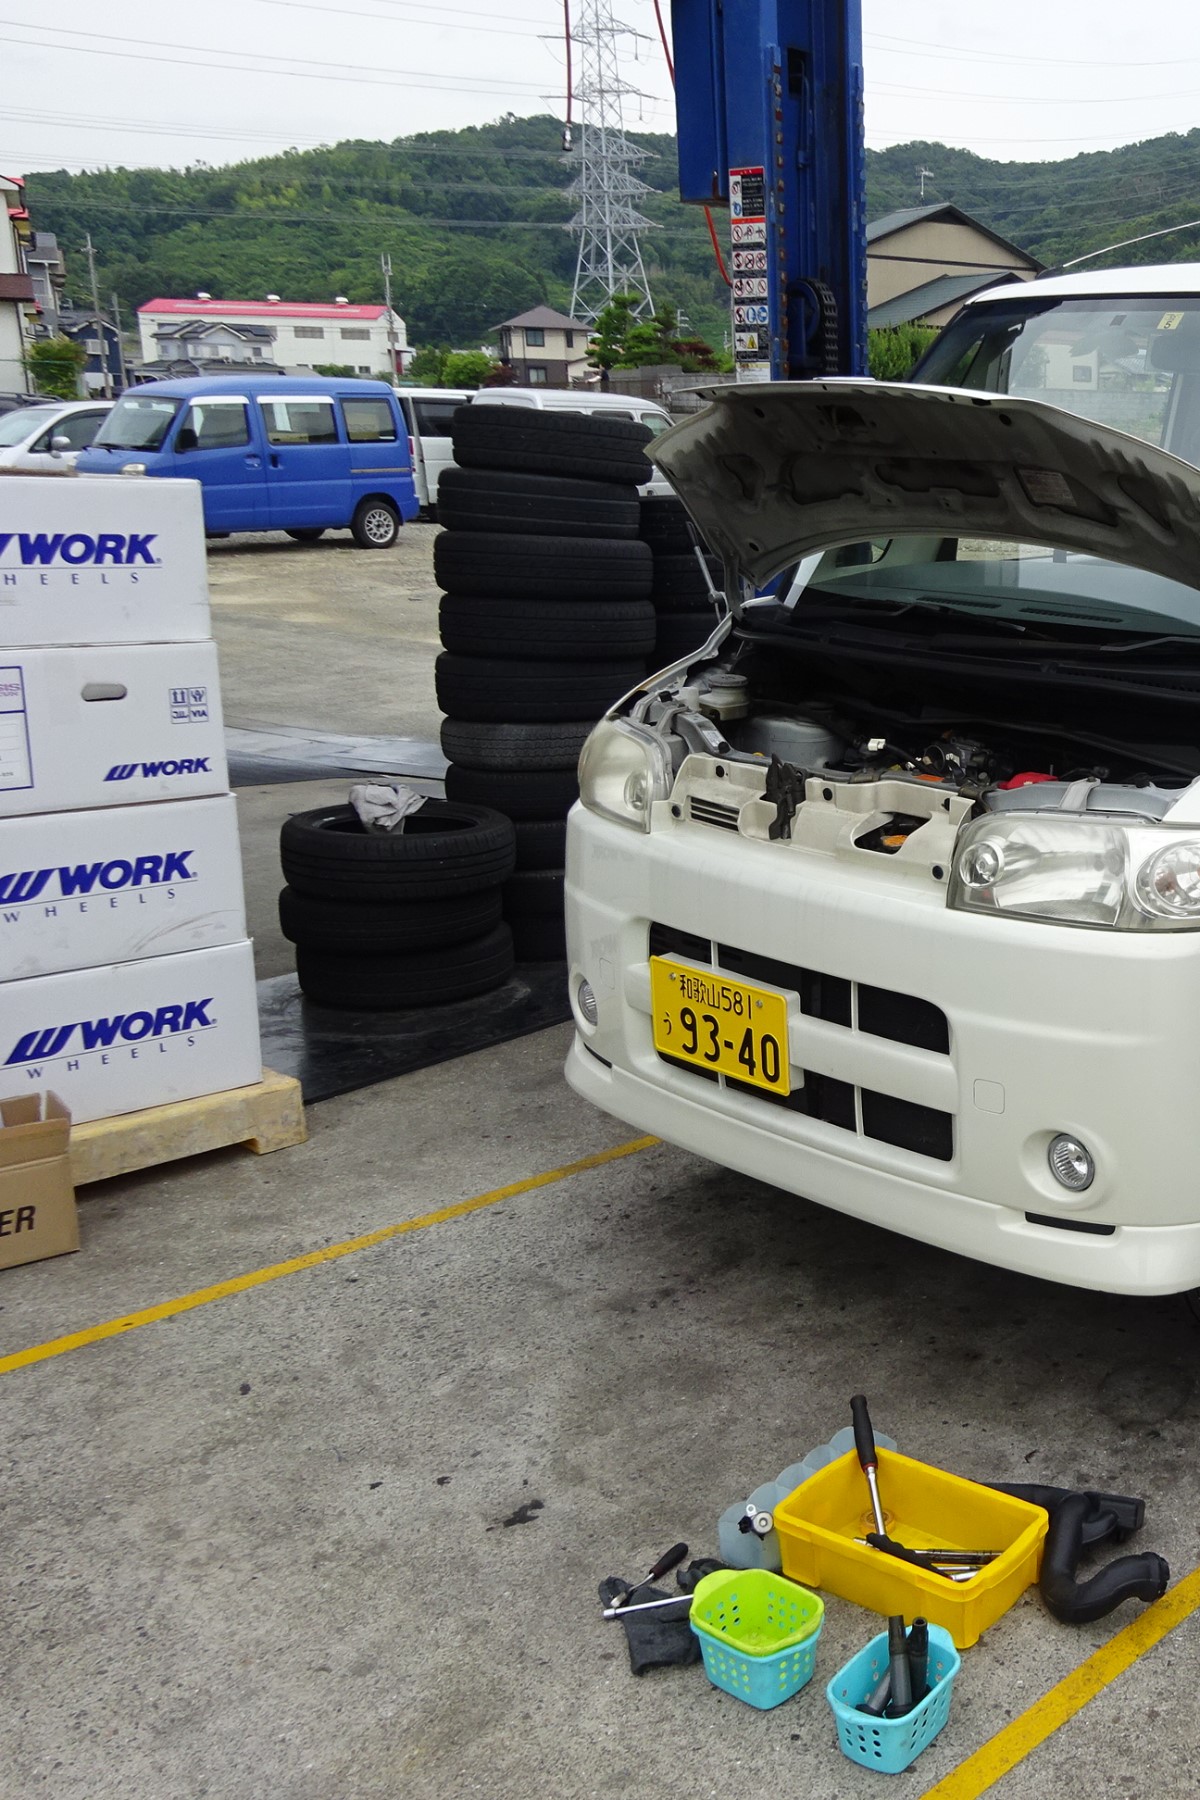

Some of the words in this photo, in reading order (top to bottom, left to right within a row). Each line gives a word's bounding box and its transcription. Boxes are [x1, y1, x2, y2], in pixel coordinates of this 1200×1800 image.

[18, 533, 159, 565] WORK
[141, 757, 211, 778] WORK
[59, 850, 195, 896] WORK
[3, 888, 176, 923] WHEELS
[81, 998, 214, 1050] WORK
[663, 1012, 672, 1036] う
[680, 1007, 780, 1083] 93-40
[26, 1036, 196, 1079] WHEELS
